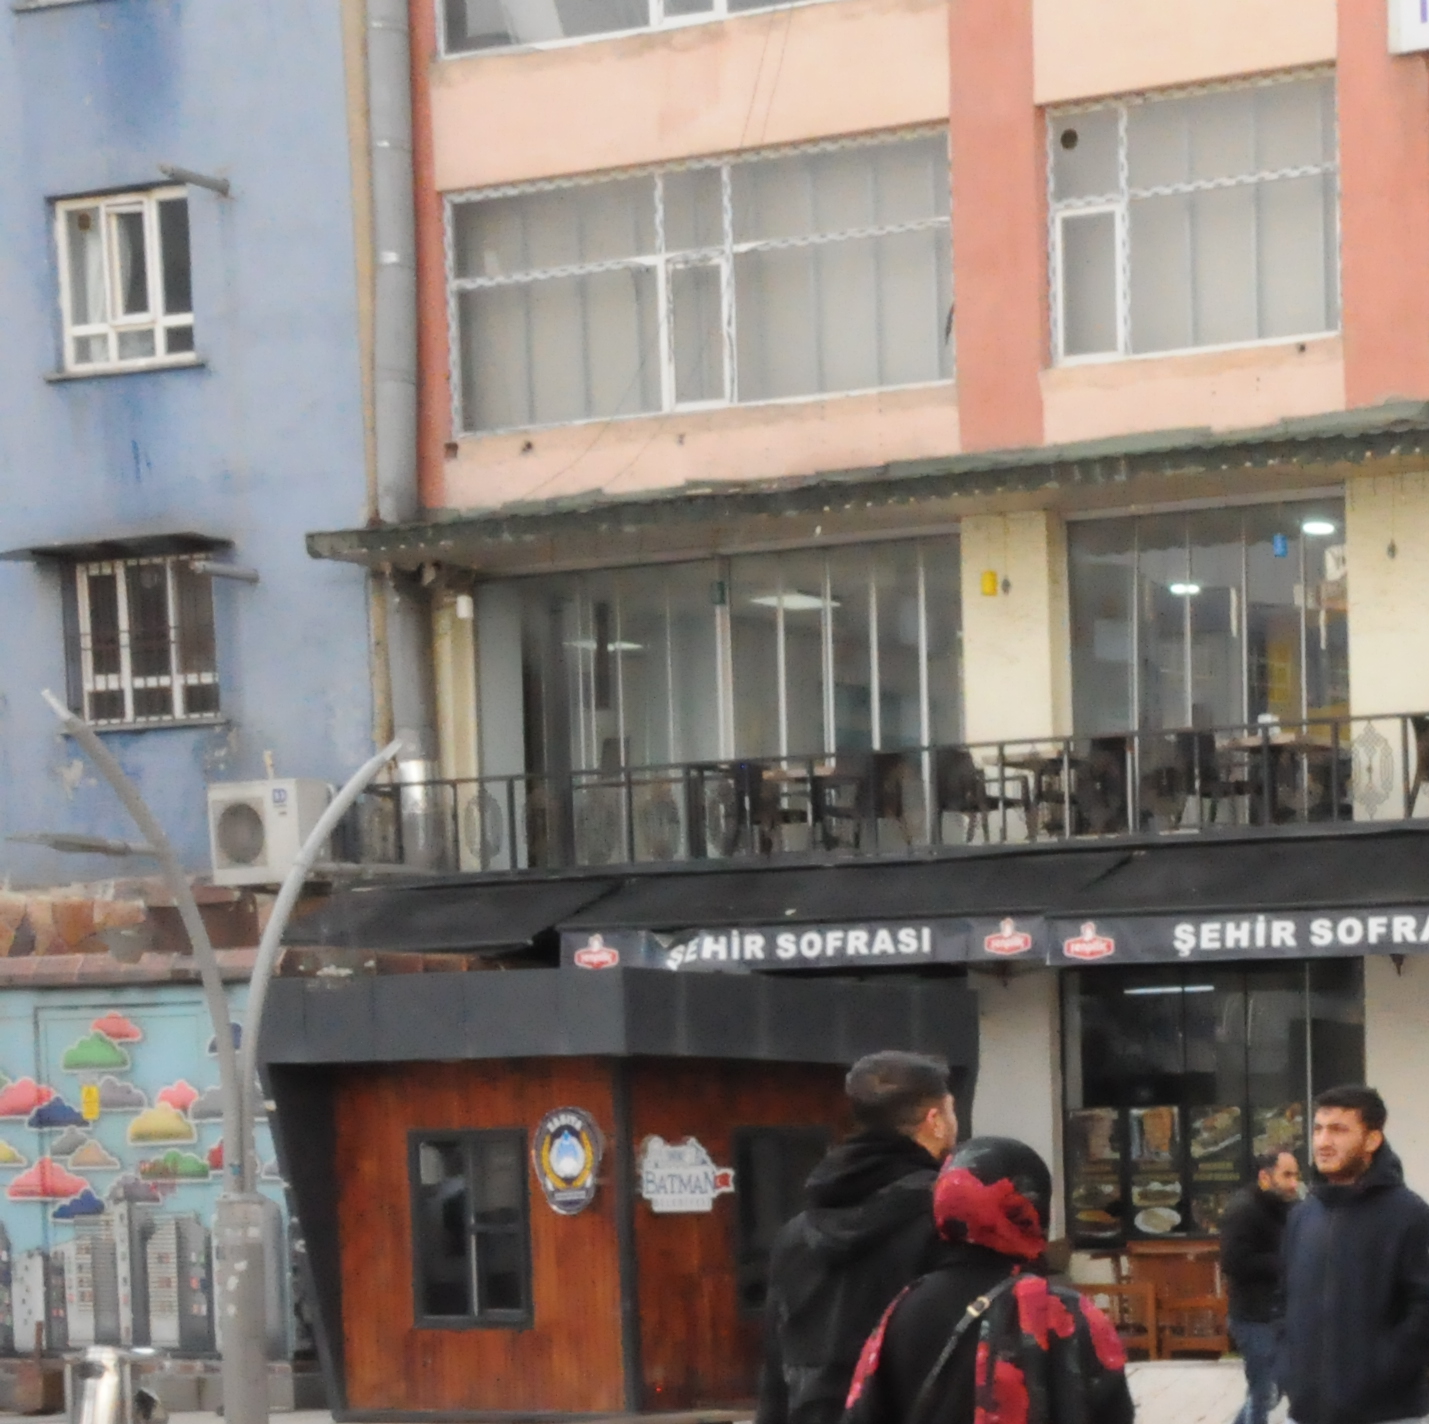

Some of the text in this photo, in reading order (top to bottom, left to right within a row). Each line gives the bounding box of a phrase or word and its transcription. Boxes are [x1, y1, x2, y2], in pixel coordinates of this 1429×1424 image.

[666, 927, 931, 971] ŞEHİR SOFRASI
[1173, 915, 1297, 957] ŞEHİR
[645, 1170, 716, 1194] BATMAN
